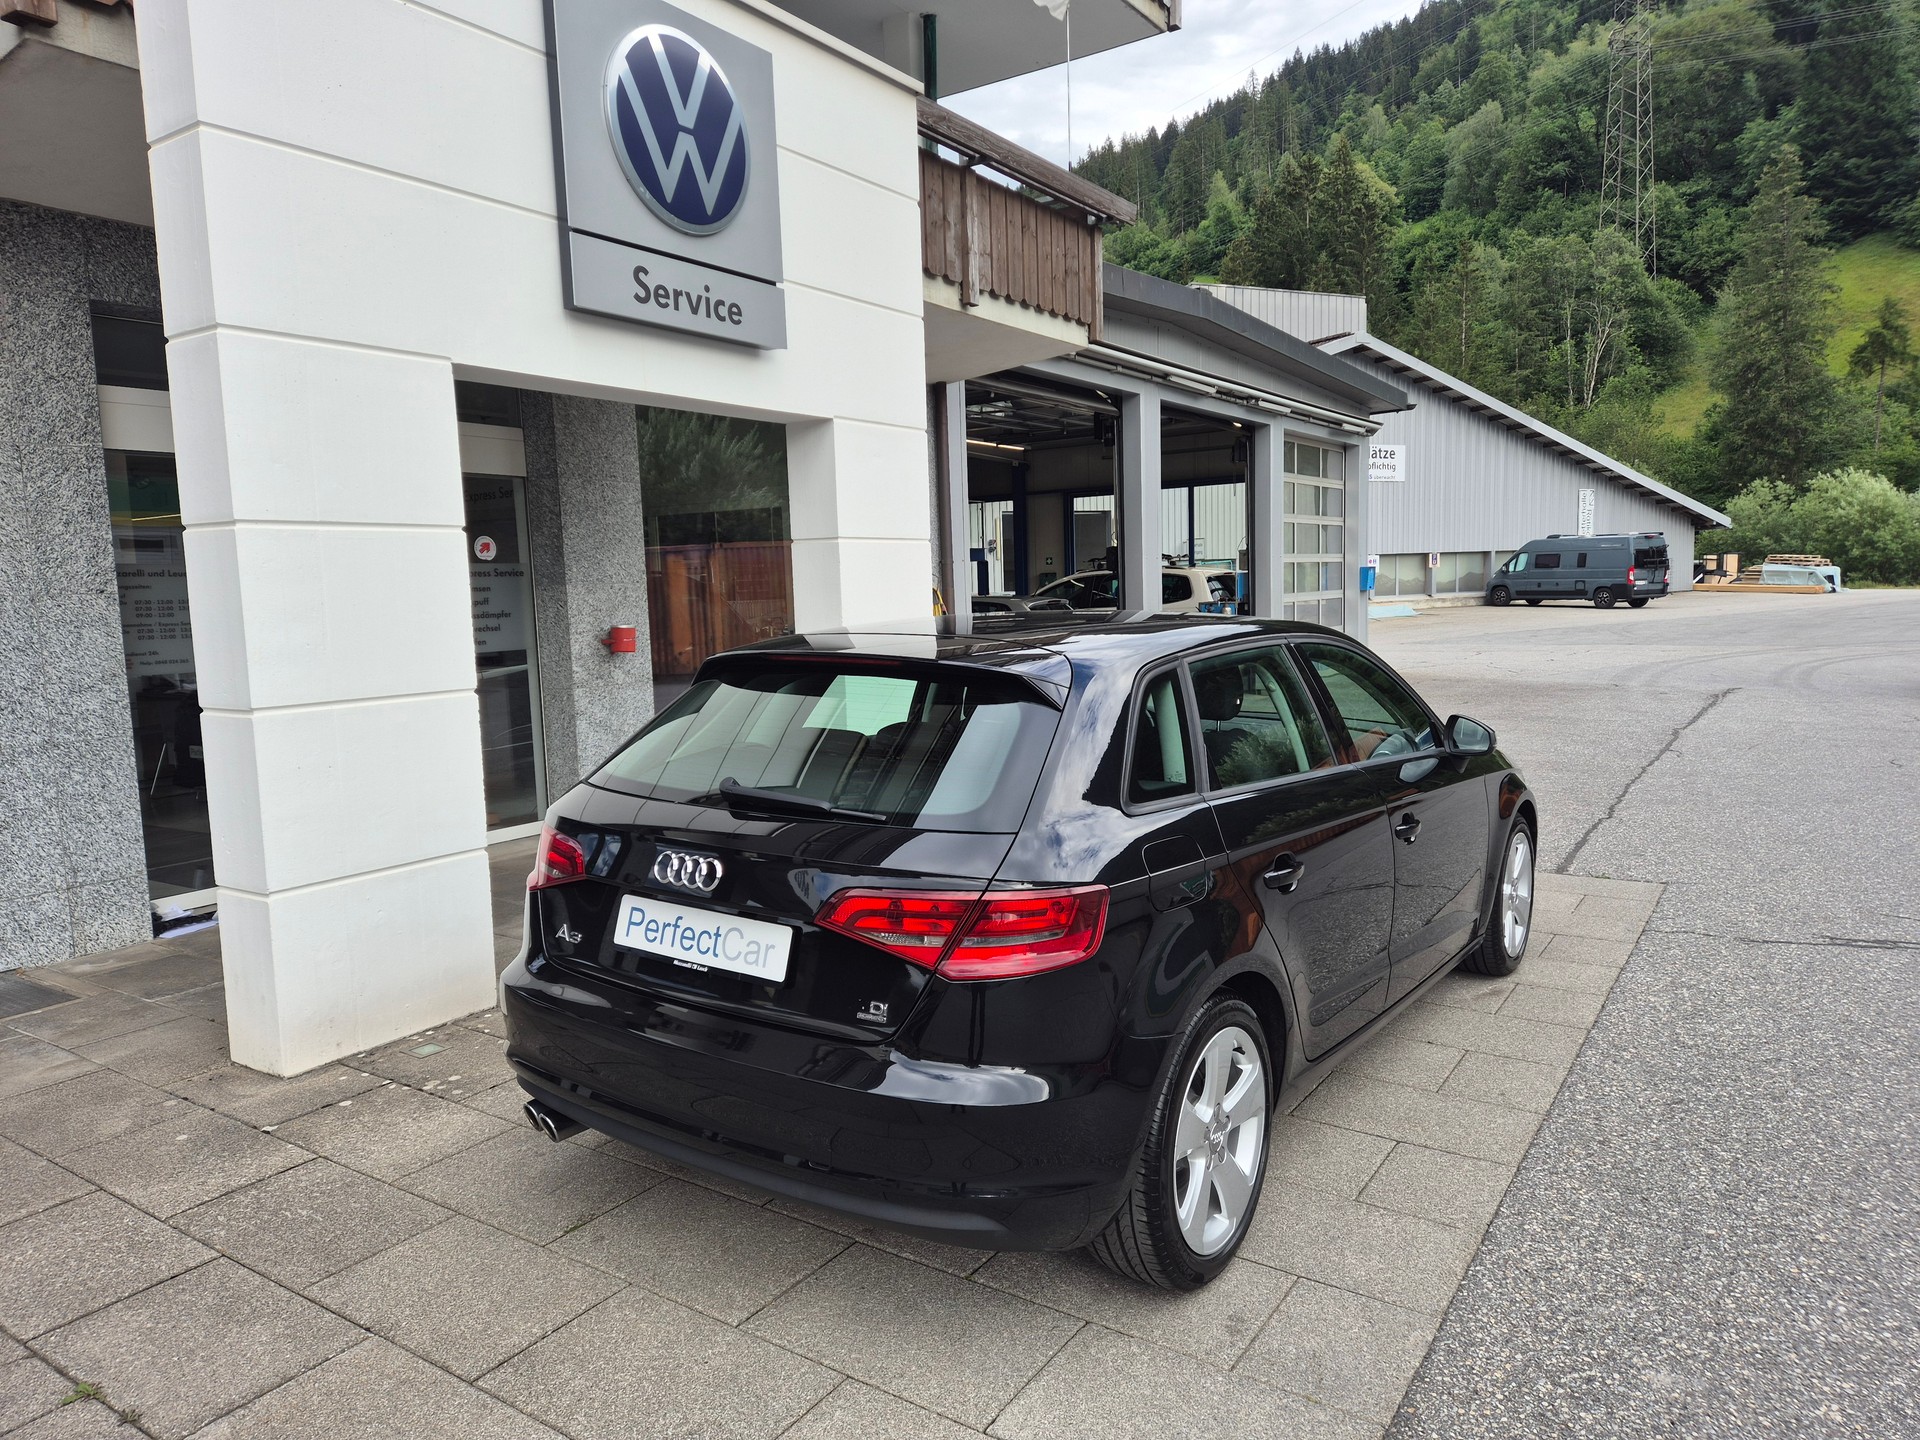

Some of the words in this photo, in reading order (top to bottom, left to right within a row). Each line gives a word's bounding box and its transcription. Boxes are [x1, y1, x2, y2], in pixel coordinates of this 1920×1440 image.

[618, 33, 743, 217] VW
[632, 264, 743, 325] Service
[147, 569, 165, 577] und
[494, 568, 525, 577] Service
[555, 923, 583, 944] A3
[625, 906, 776, 969] PerfectCar
